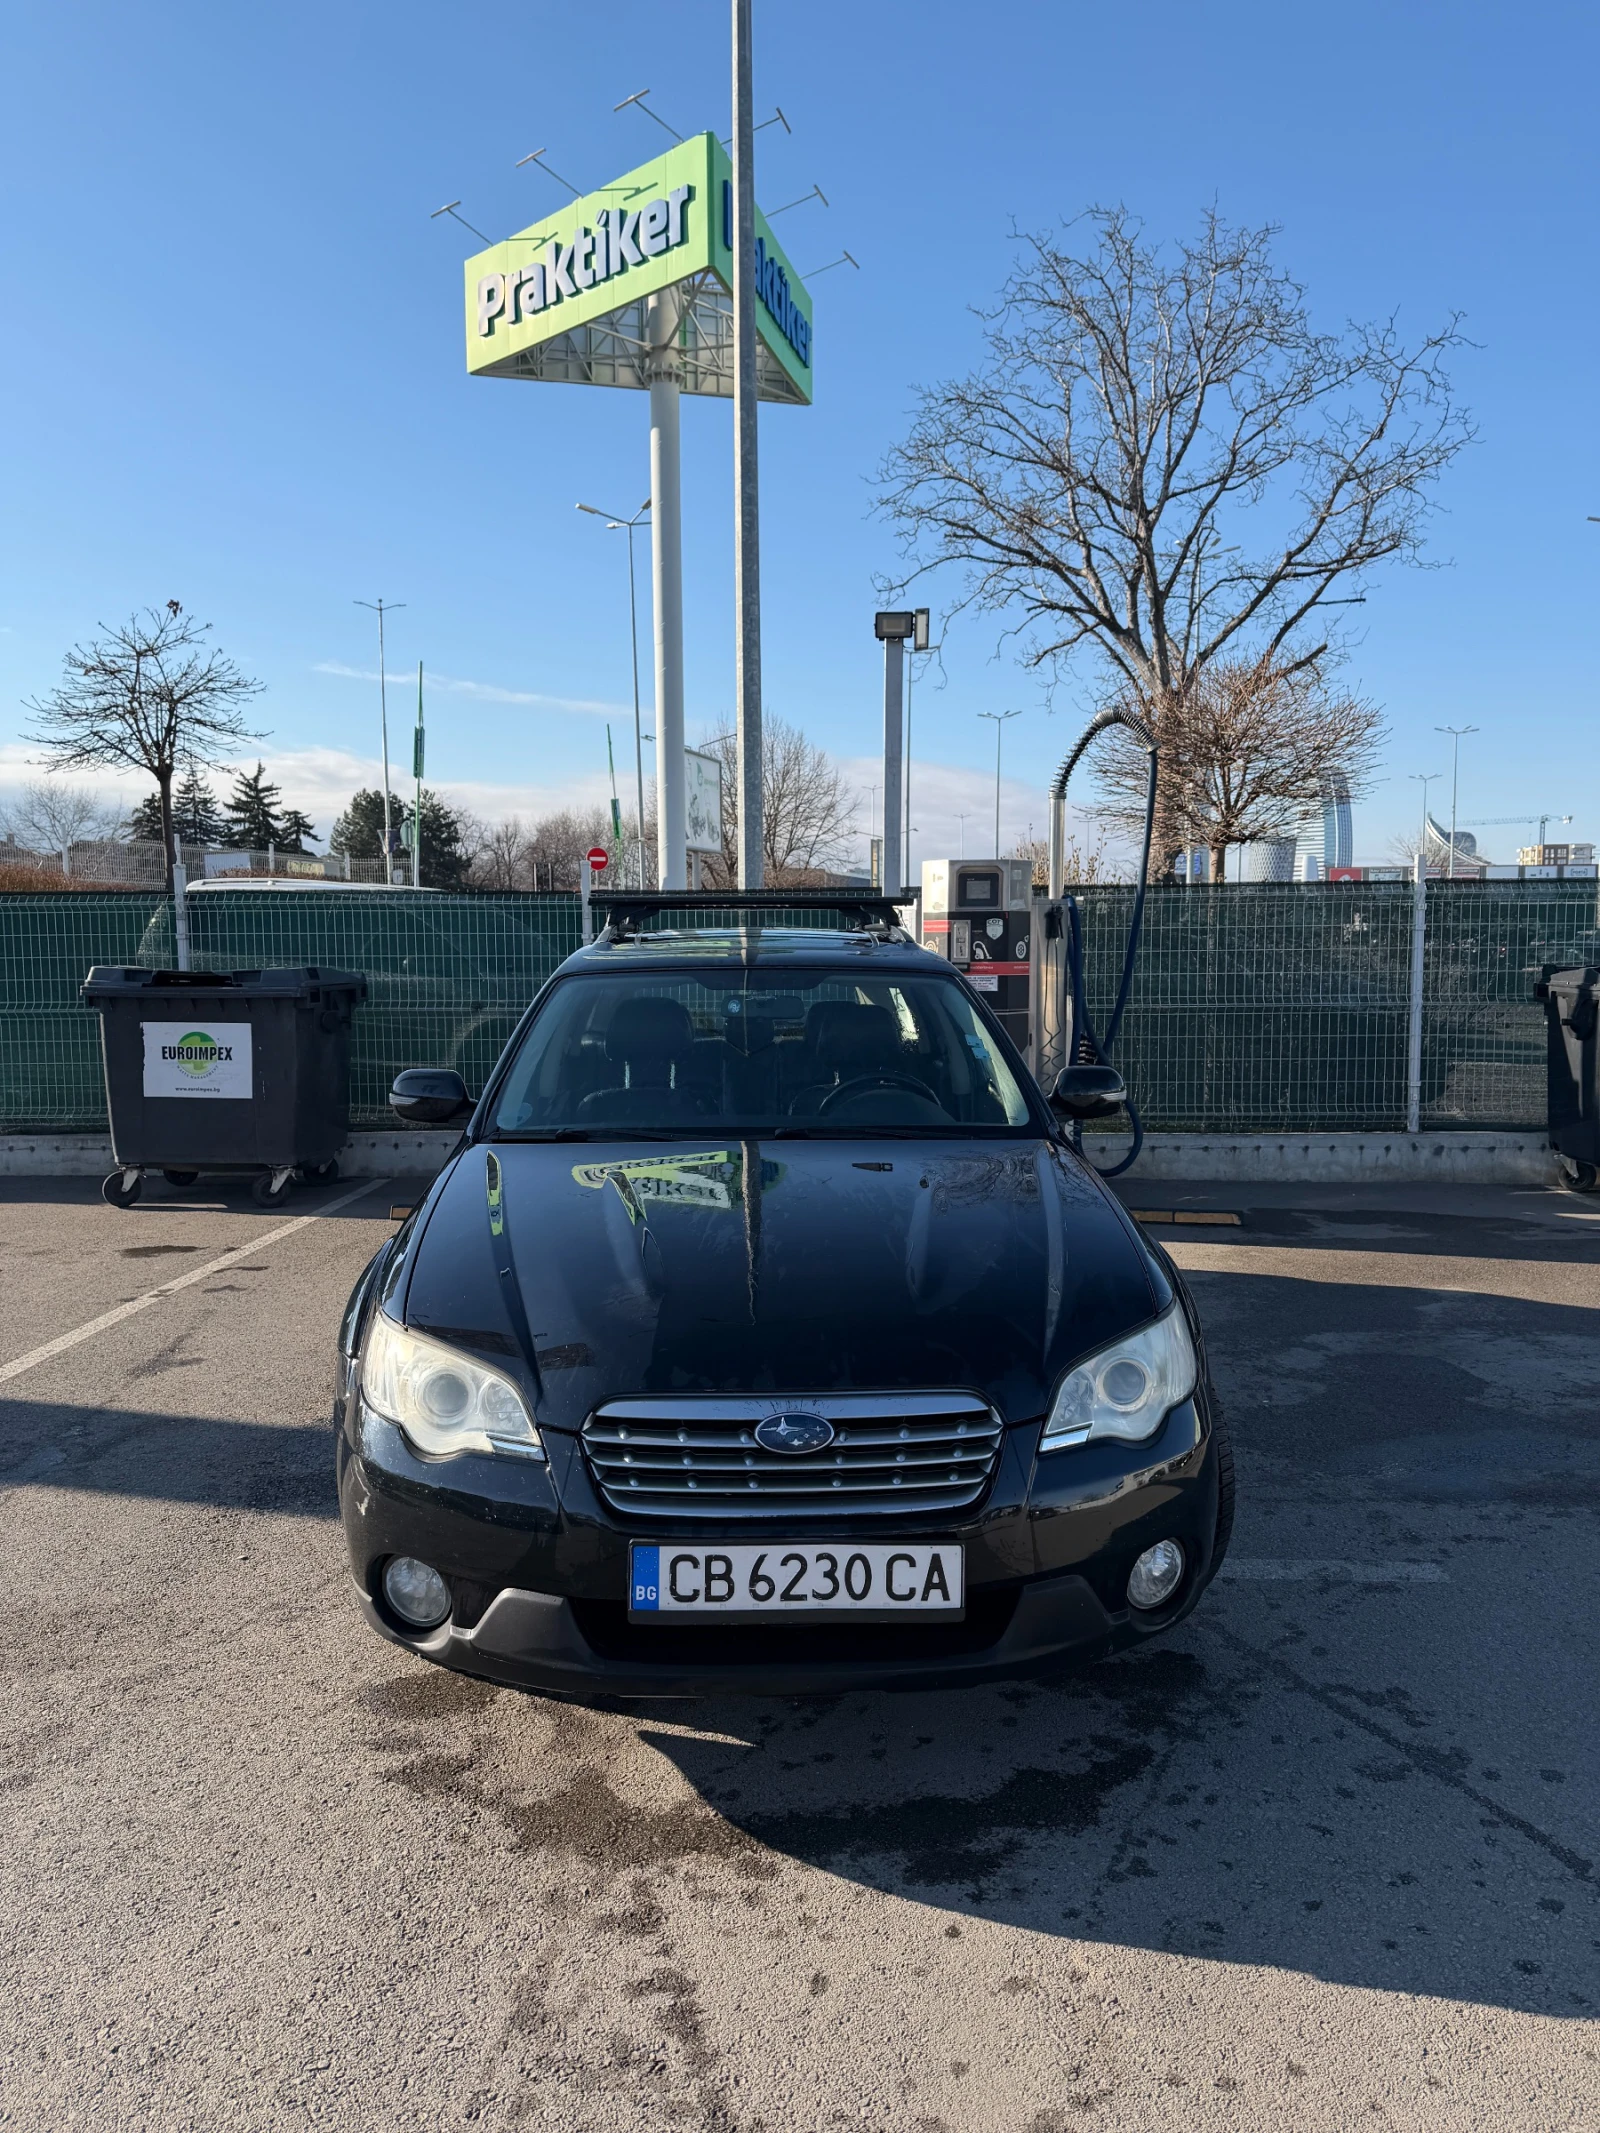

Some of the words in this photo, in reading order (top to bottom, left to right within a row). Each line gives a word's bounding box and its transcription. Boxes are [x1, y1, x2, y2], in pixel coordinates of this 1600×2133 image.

[478, 183, 696, 338] Praktiker
[161, 1046, 233, 1061] EUROIMPEX
[635, 1585, 657, 1601] BG
[669, 1554, 735, 1603] CB
[749, 1552, 873, 1603] 6230
[885, 1553, 951, 1602] CA
